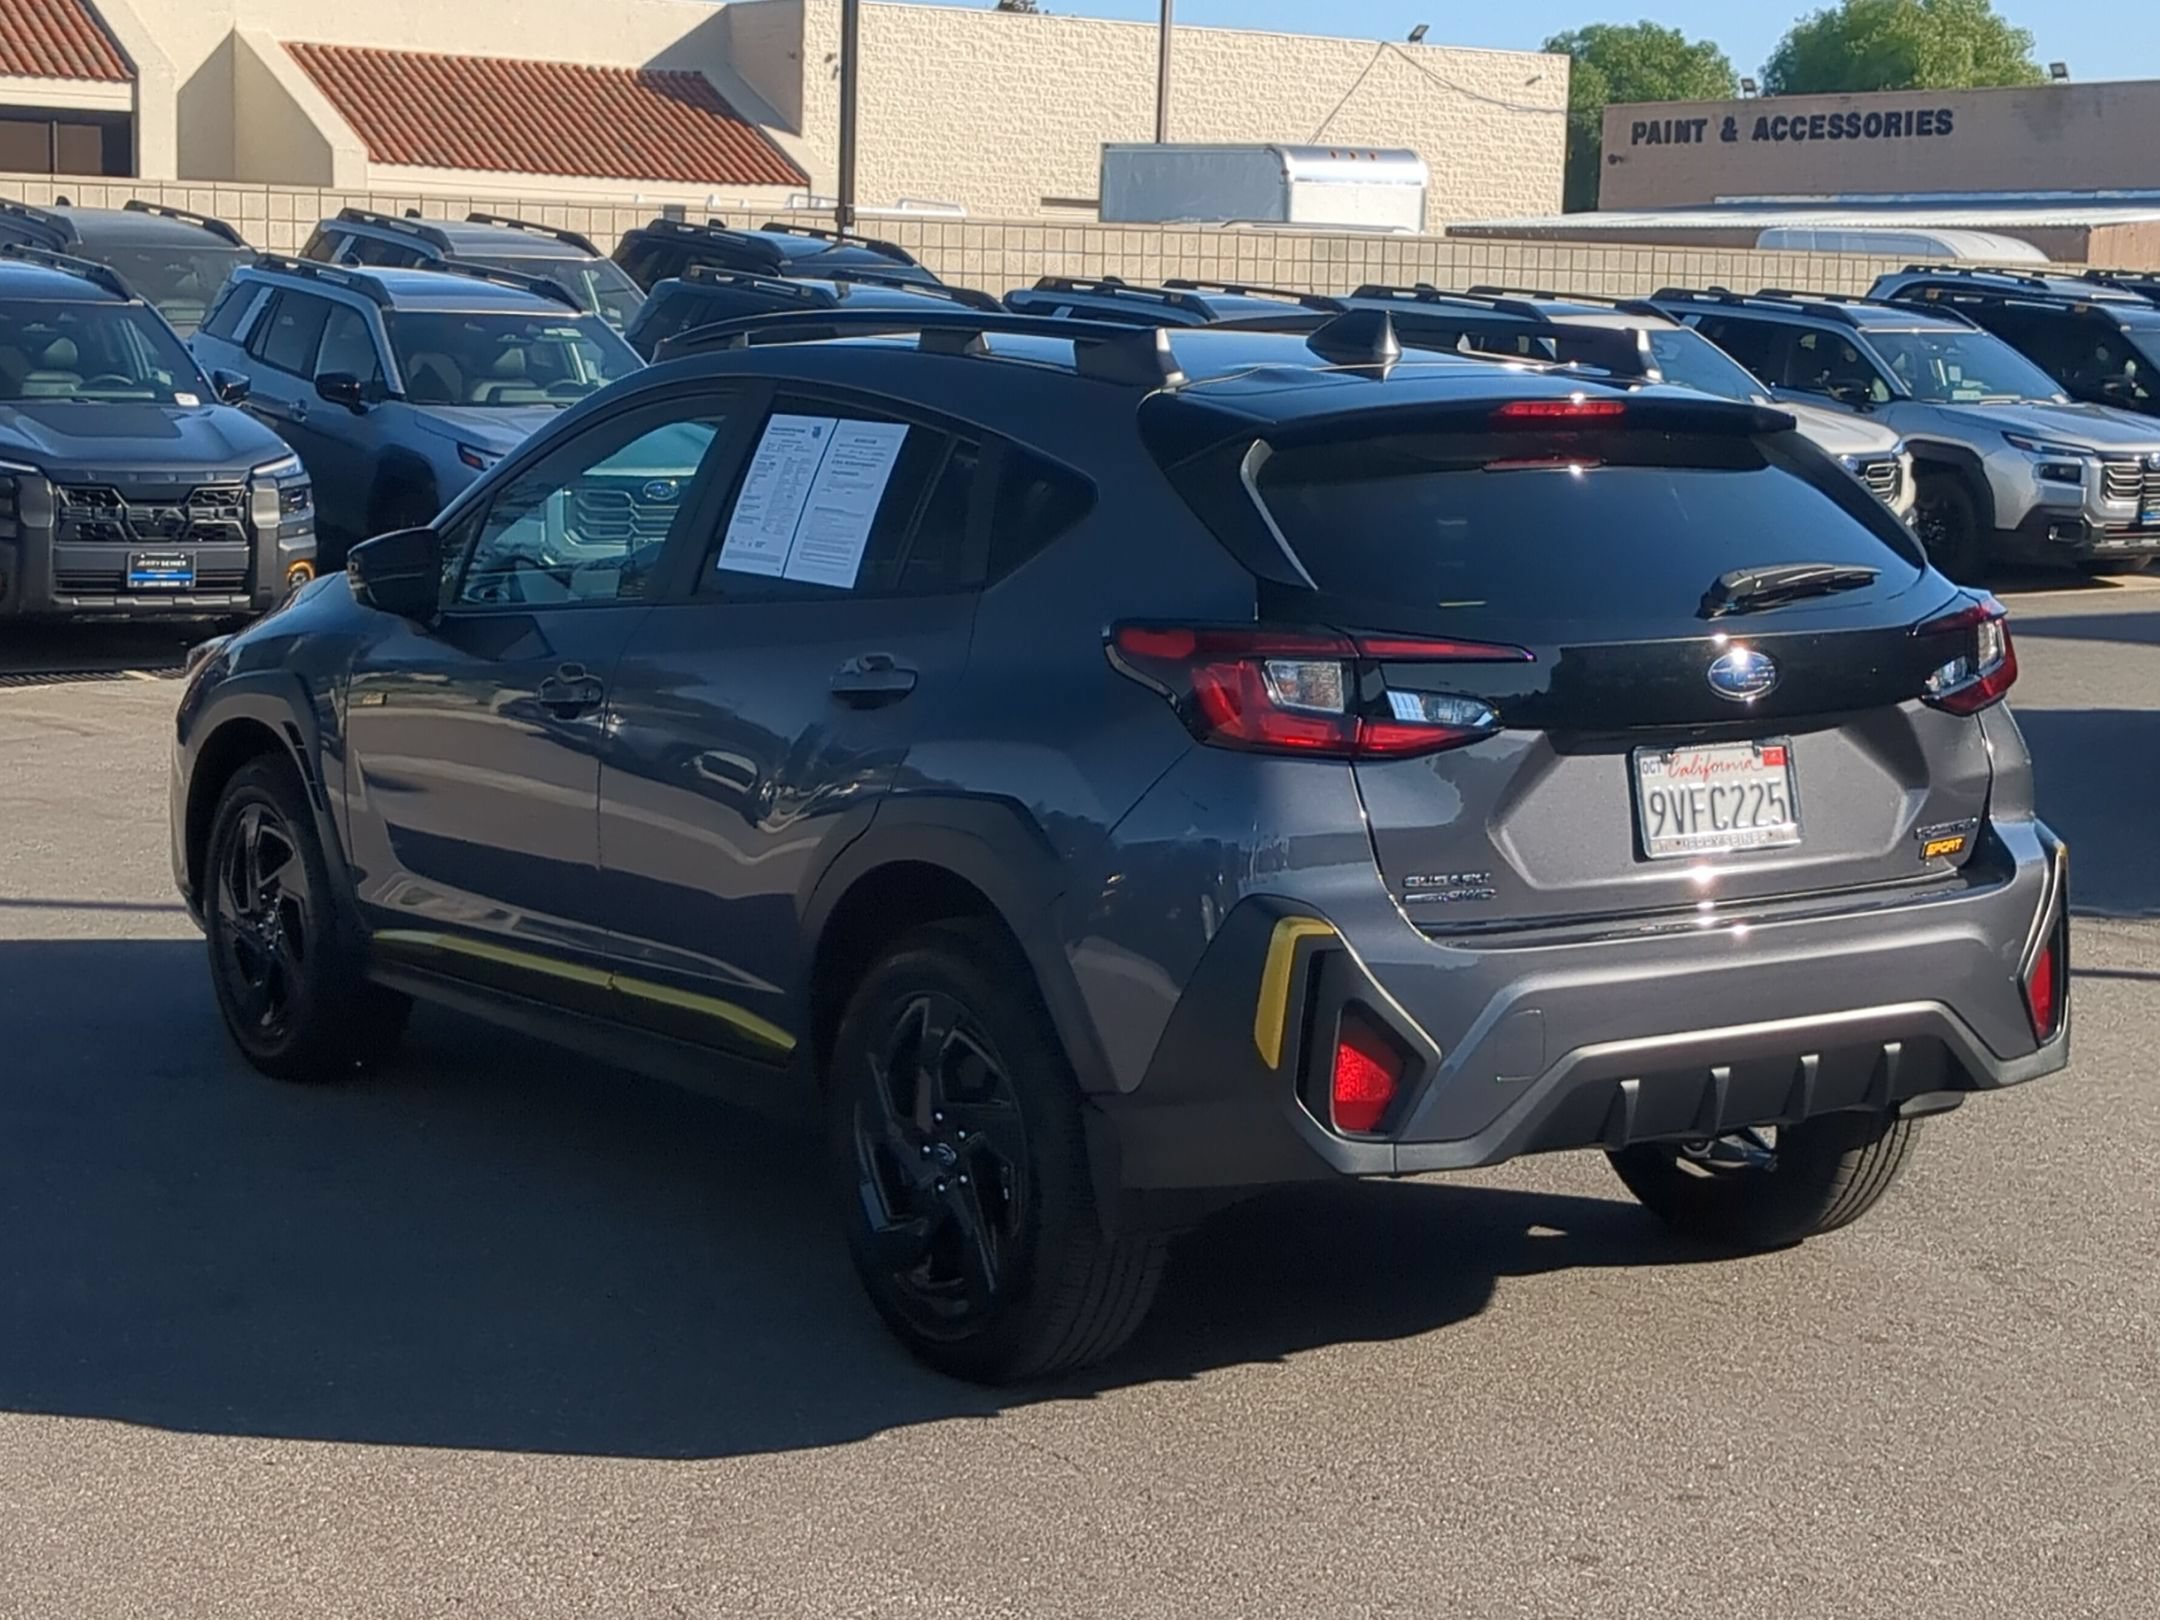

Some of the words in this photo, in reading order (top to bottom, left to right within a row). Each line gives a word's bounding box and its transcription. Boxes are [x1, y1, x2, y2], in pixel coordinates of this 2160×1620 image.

[1631, 118, 1708, 145] PAINT
[1720, 115, 1738, 142] &
[1752, 109, 1954, 142] ACCESSORIES
[1642, 760, 1662, 775] OCT
[1667, 751, 1763, 783] California
[1649, 780, 1787, 837] 9VFC225
[1925, 838, 1963, 856] SPORT
